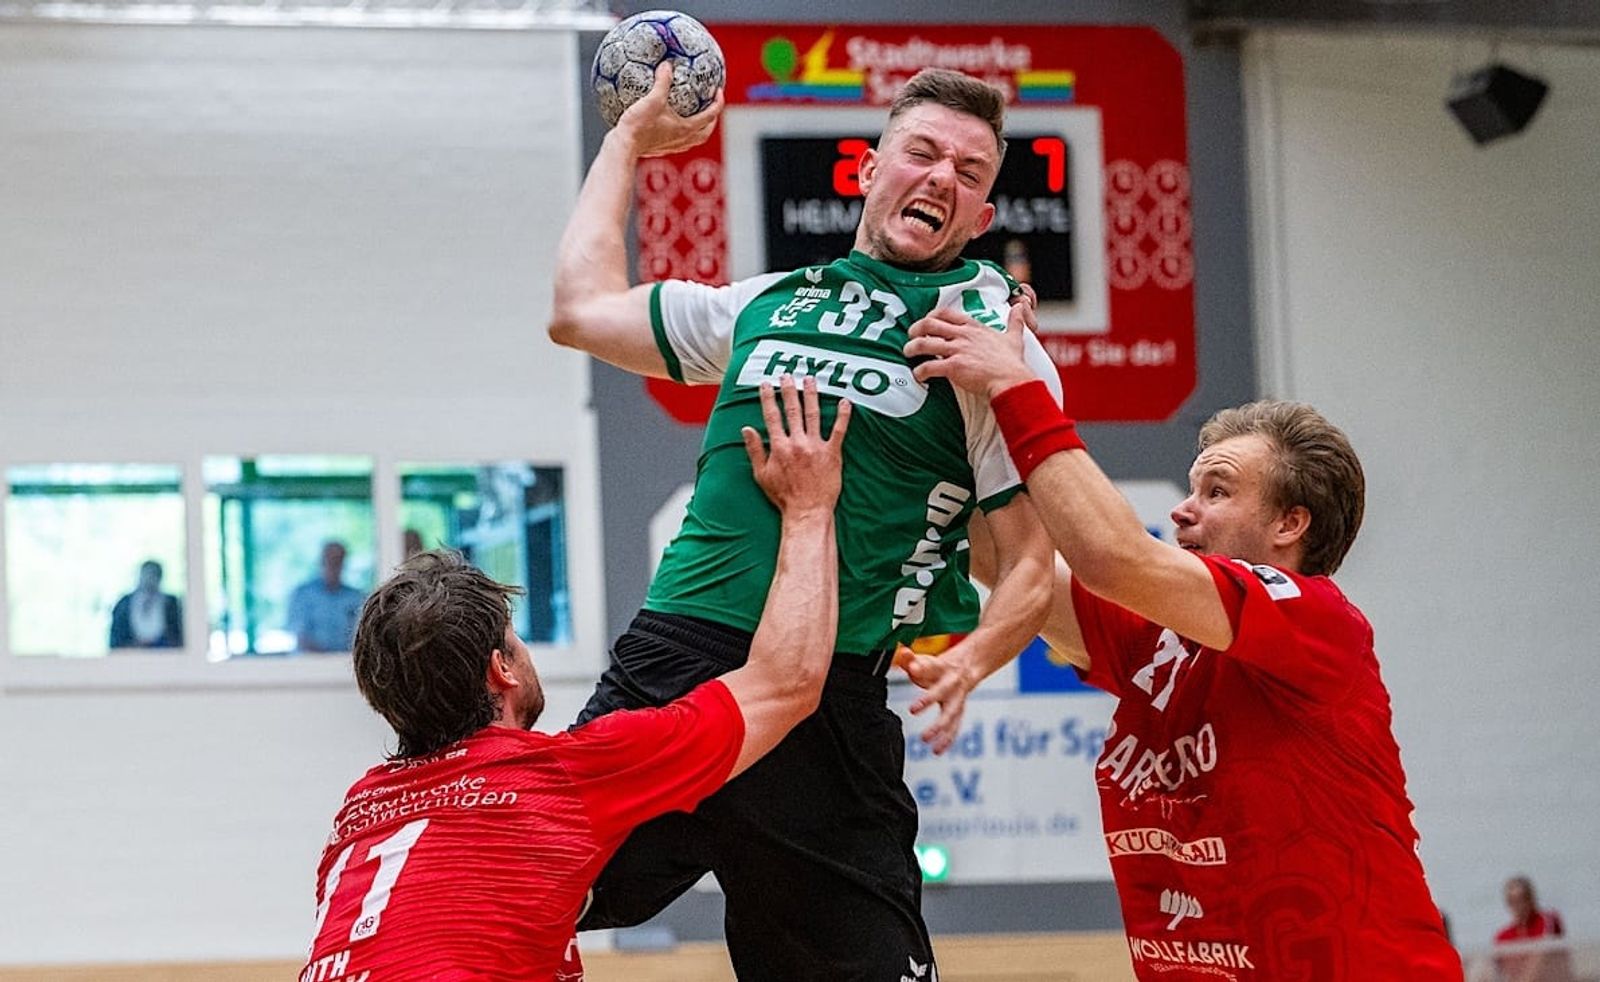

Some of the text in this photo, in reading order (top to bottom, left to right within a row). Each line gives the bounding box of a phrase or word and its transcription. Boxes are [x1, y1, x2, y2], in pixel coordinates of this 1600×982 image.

[846, 36, 1031, 69] Stadtwerke
[989, 196, 1070, 232] ÄSTE
[795, 286, 831, 298] erima
[818, 281, 907, 341] 37
[763, 351, 890, 396] HYLO
[996, 717, 1051, 758] für
[1129, 937, 1255, 969] WOLLFABRIK
